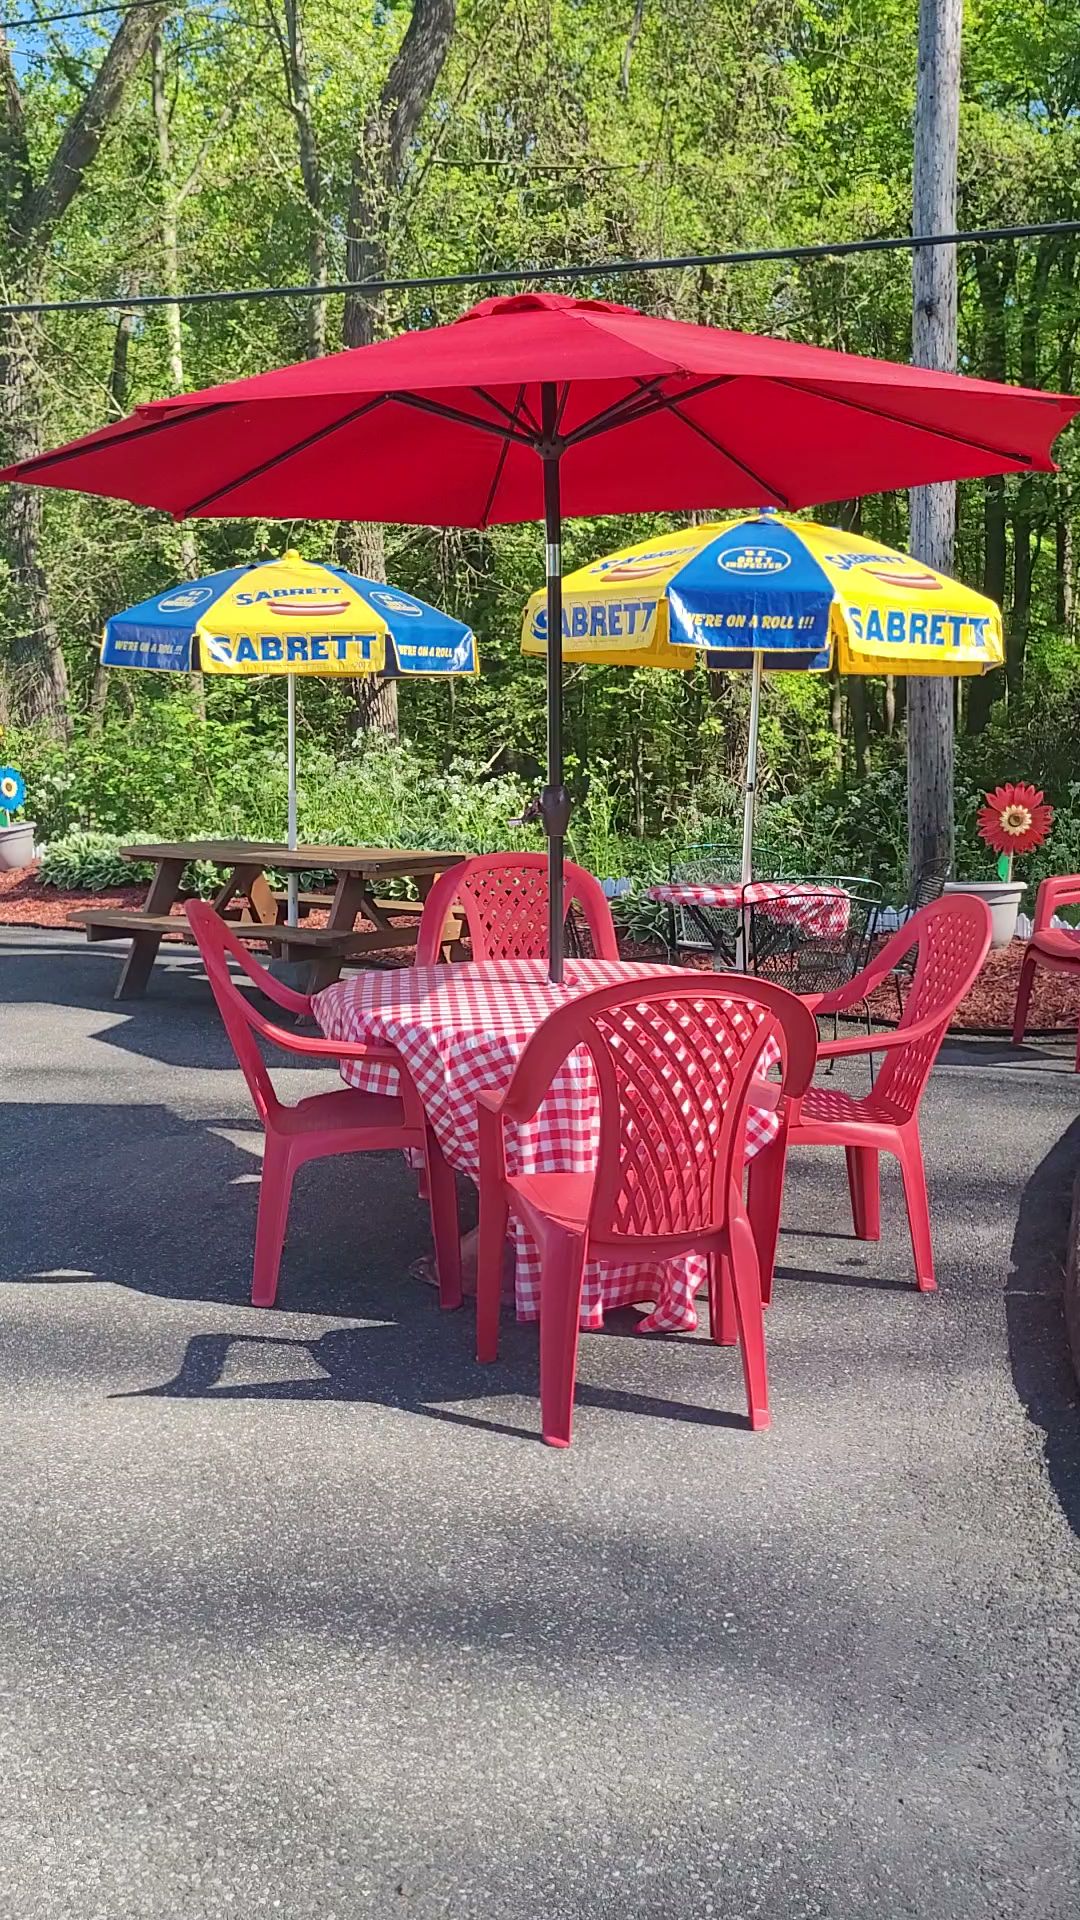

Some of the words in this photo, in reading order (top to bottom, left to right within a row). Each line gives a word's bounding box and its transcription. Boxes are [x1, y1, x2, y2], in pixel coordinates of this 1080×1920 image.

[825, 554, 906, 570] SABRETT
[234, 587, 342, 606] SABRETT
[531, 600, 657, 640] SABRETT
[726, 614, 746, 627] ON
[748, 615, 758, 628] A
[761, 615, 794, 629] ROLL
[798, 616, 814, 629] !!!
[848, 607, 990, 647] SABRETT
[207, 634, 377, 662] SABRETT
[436, 647, 452, 658] ROLL
